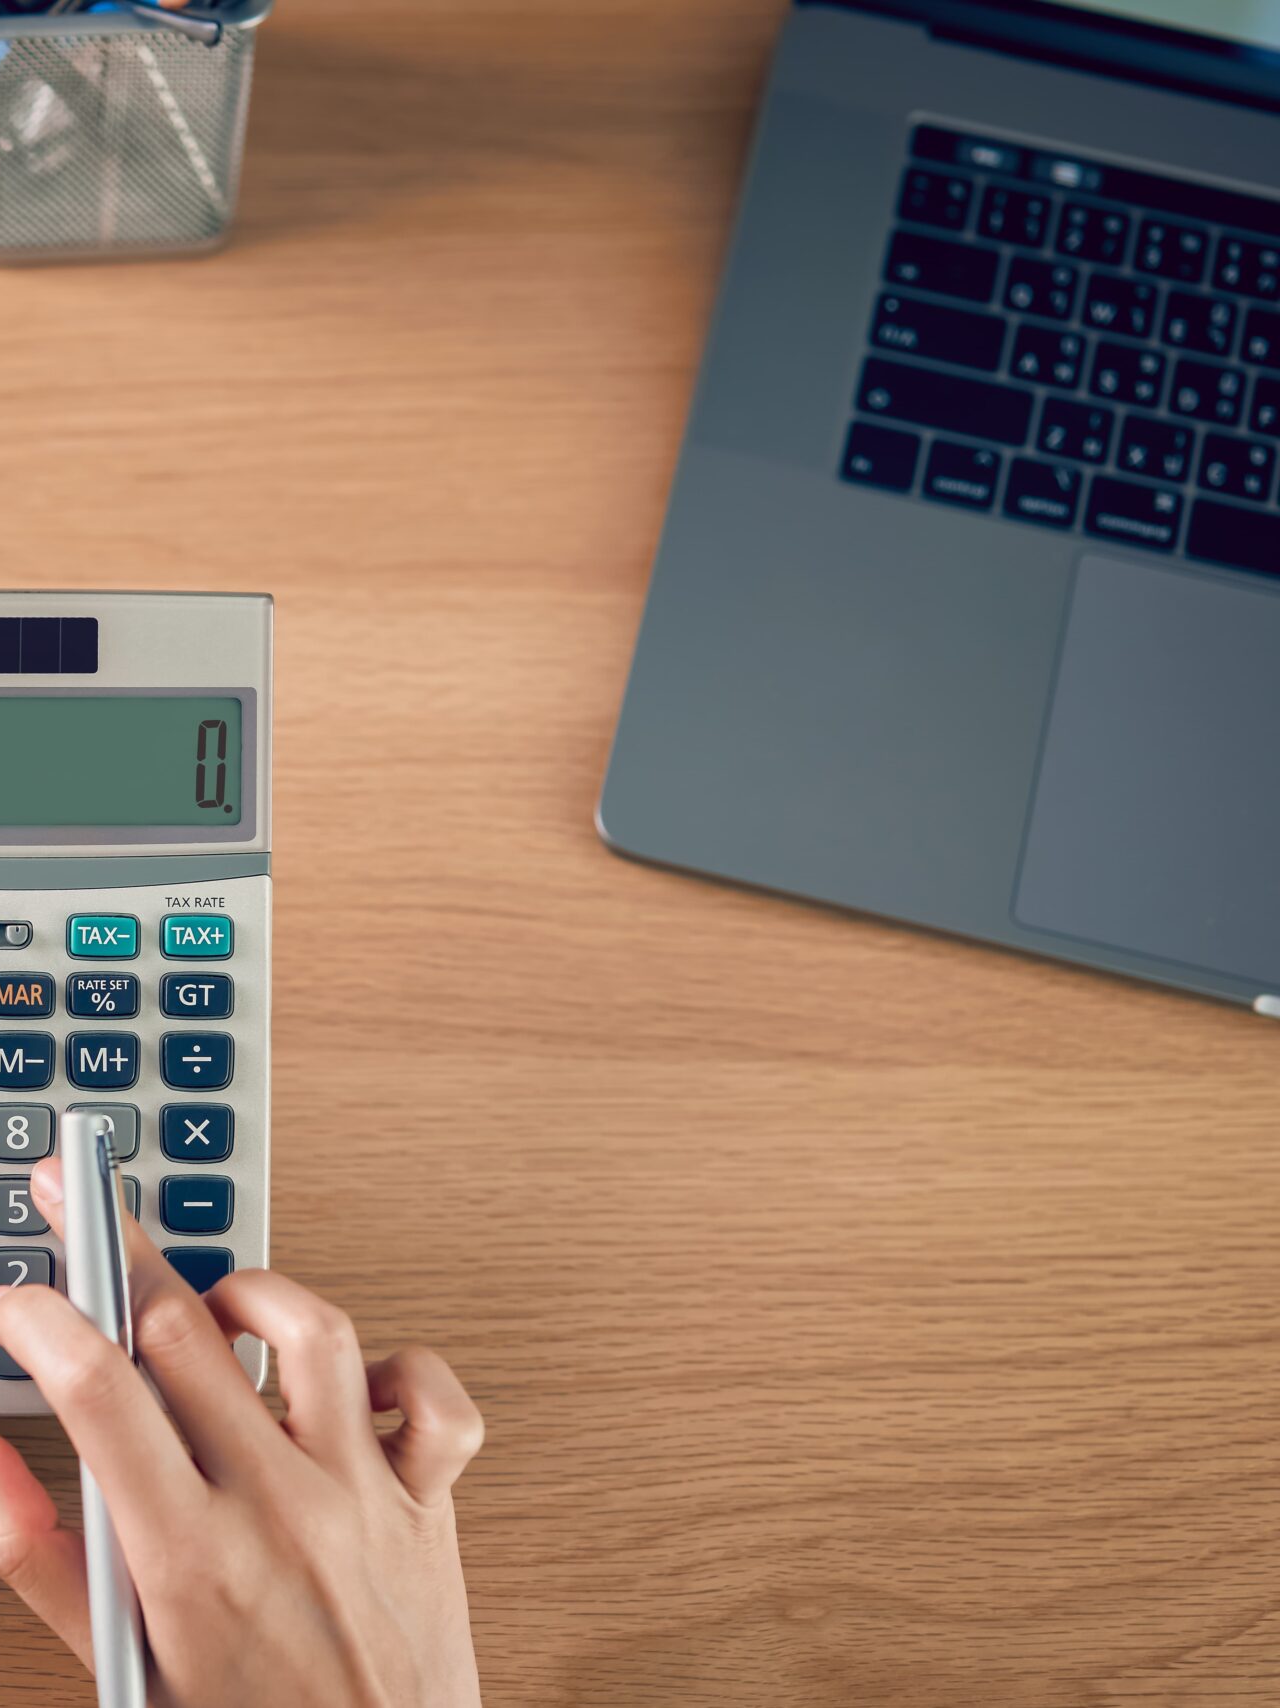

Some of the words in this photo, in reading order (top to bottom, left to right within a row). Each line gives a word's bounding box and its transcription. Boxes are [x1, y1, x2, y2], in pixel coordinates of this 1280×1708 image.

[165, 897, 191, 908] TAX
[194, 897, 225, 908] RATE
[77, 926, 130, 945] TAX-
[170, 926, 225, 945] TAX+
[77, 979, 107, 990] RATE
[109, 979, 130, 990] SET
[177, 983, 215, 1006] GT
[91, 992, 116, 1012] %
[79, 1047, 129, 1073] M+
[6, 1115, 30, 1150] 8
[8, 1189, 29, 1224] 5
[7, 1260, 29, 1288] 2
